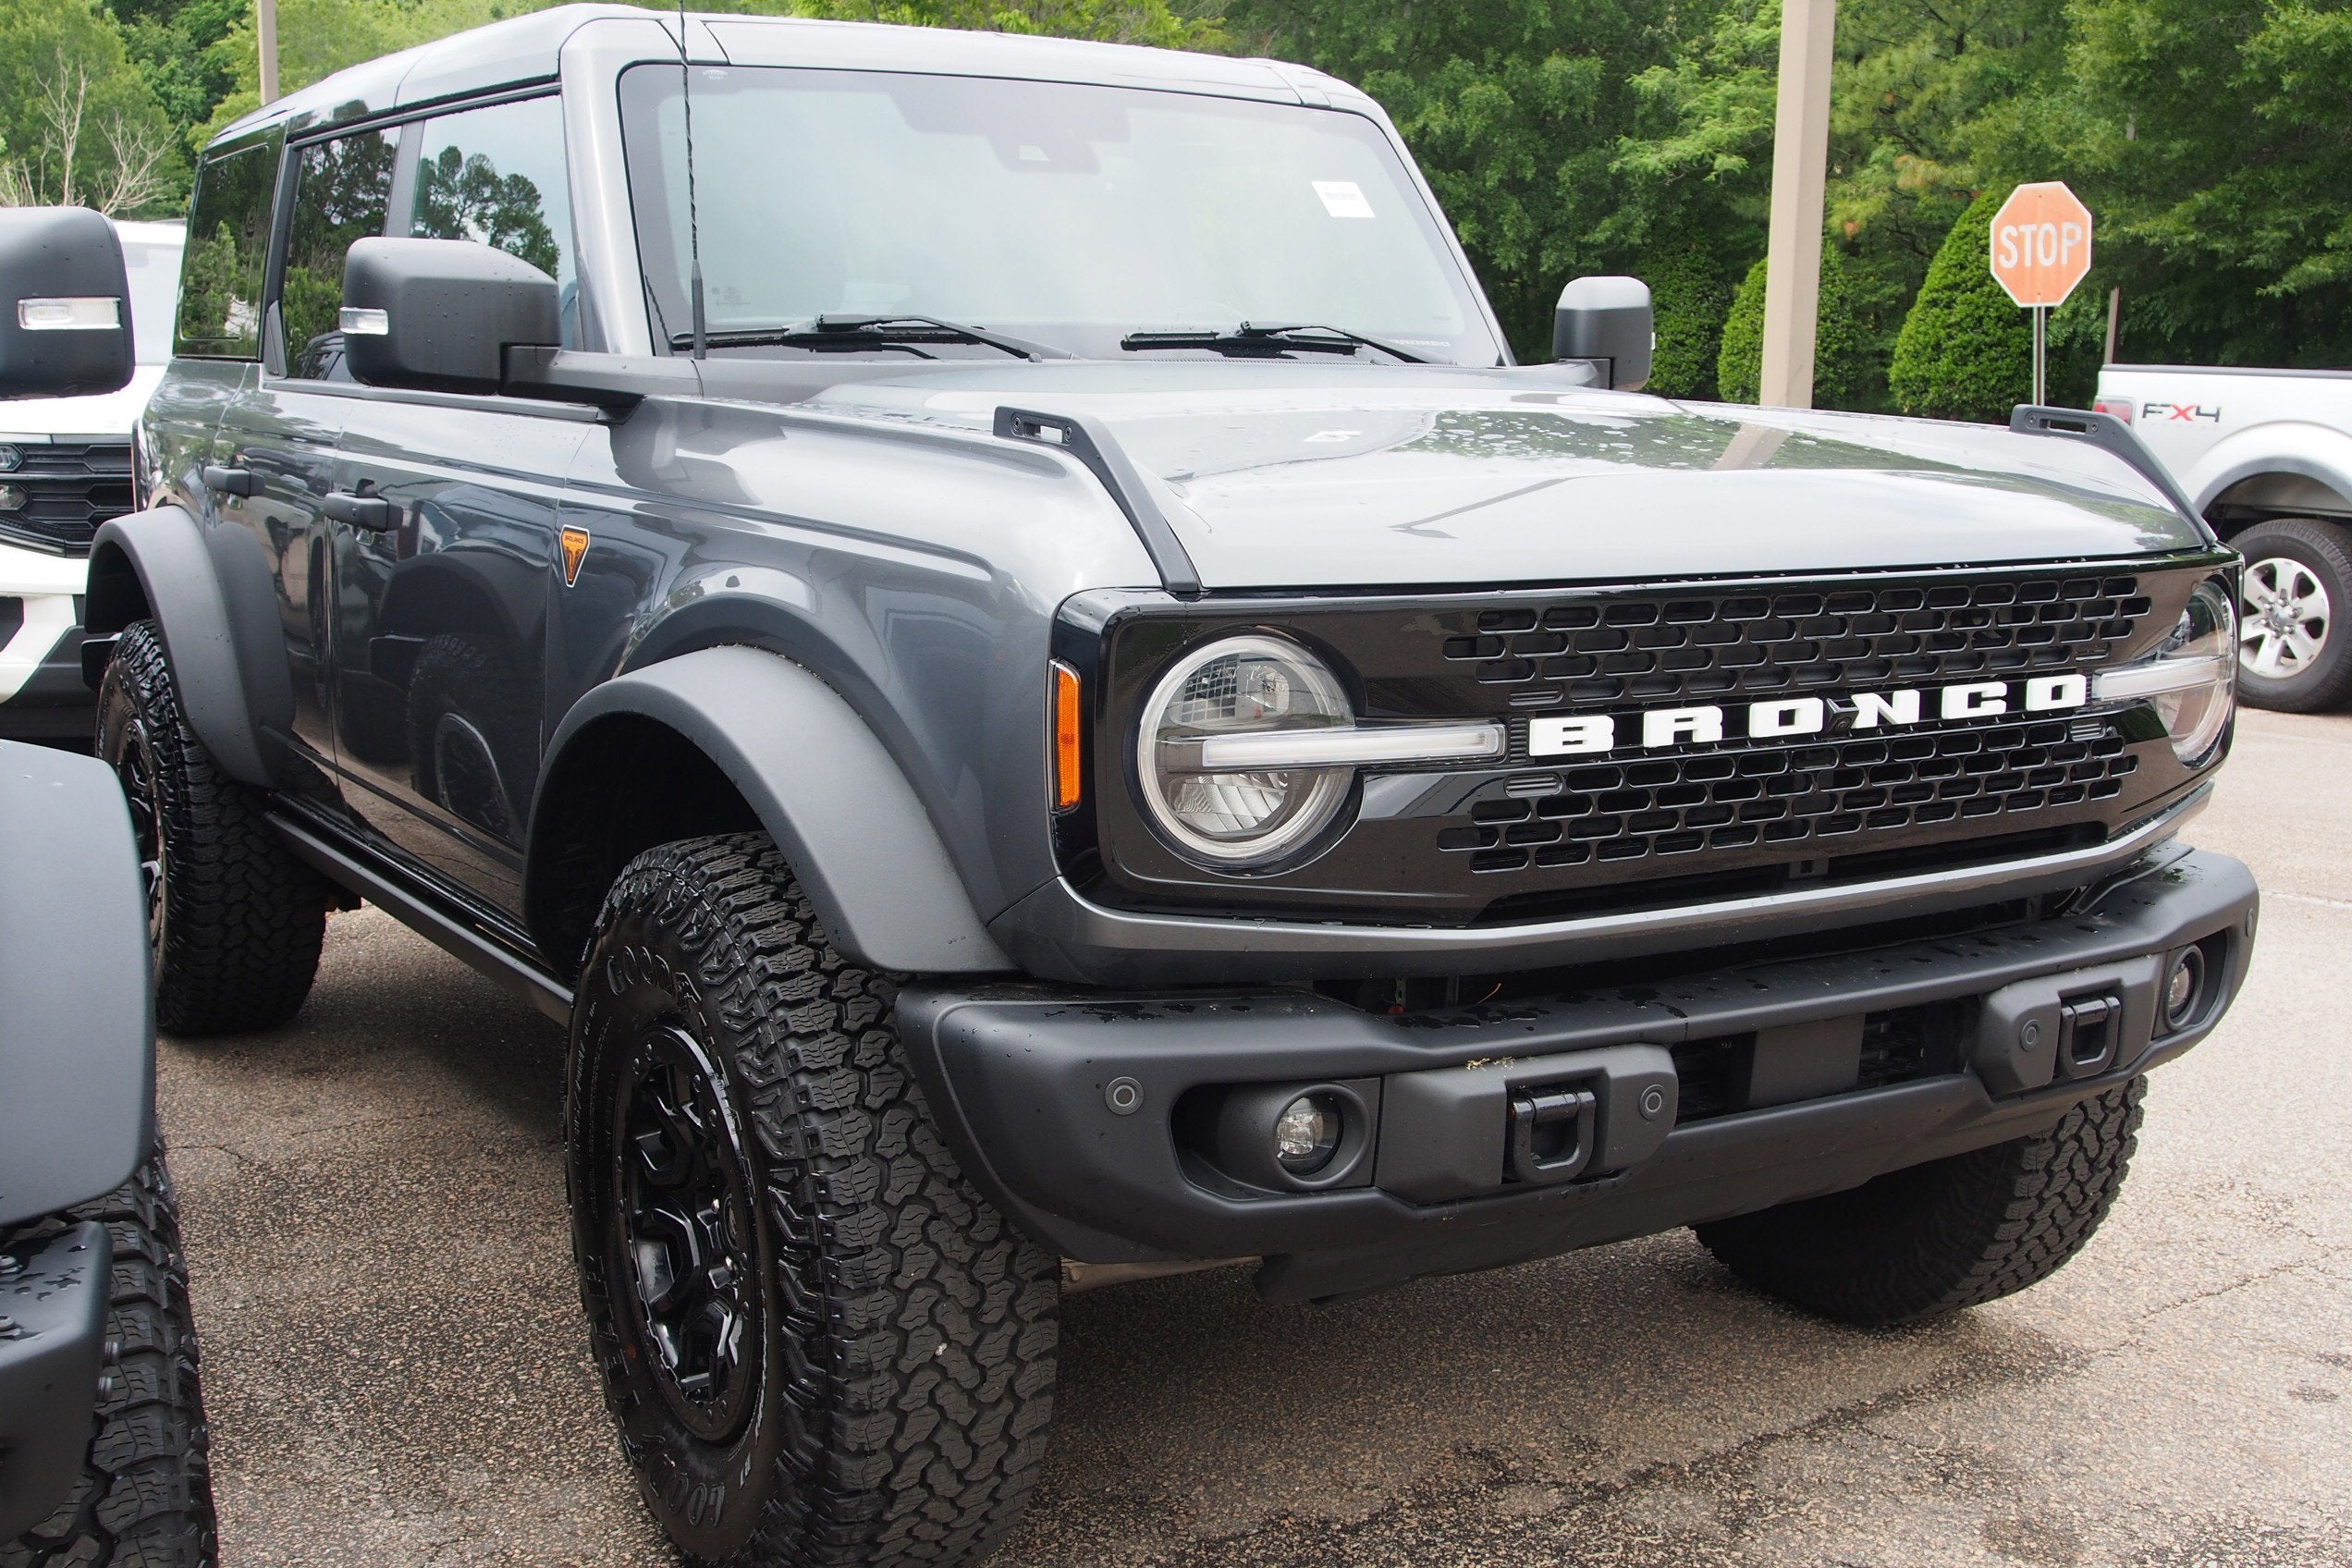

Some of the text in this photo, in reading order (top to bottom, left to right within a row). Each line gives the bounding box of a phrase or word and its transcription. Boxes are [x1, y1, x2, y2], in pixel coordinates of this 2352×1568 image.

[1998, 222, 2082, 268] STOP
[2141, 403, 2221, 423] FX4
[1528, 673, 2087, 757] BRONCO
